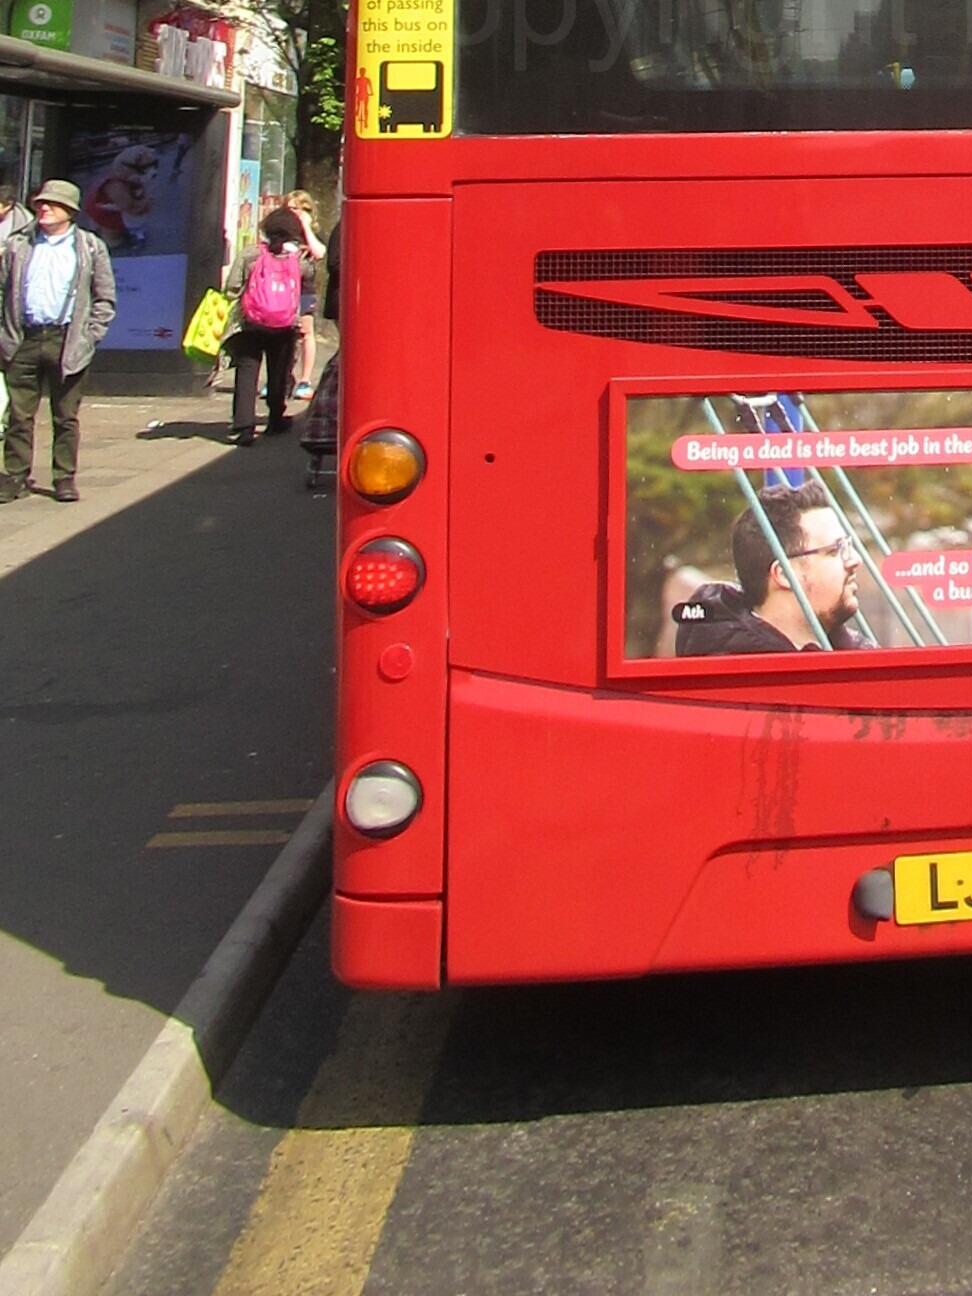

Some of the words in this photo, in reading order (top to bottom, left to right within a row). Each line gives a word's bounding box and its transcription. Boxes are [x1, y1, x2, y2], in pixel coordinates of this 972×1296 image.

[362, 19, 388, 32] this
[394, 19, 420, 32] bus
[427, 21, 447, 32] on
[21, 29, 55, 41] OXFAM
[366, 40, 390, 54] the
[396, 40, 442, 54] inside
[687, 441, 739, 466] Being
[743, 449, 754, 459] a
[758, 439, 793, 459] dad
[797, 440, 813, 457] is
[816, 437, 845, 457] the
[849, 436, 888, 457] best
[888, 435, 919, 462] job
[923, 436, 940, 454] in
[944, 434, 972, 454] the
[895, 555, 945, 577] ...and
[949, 560, 969, 575] so
[933, 587, 945, 601] a
